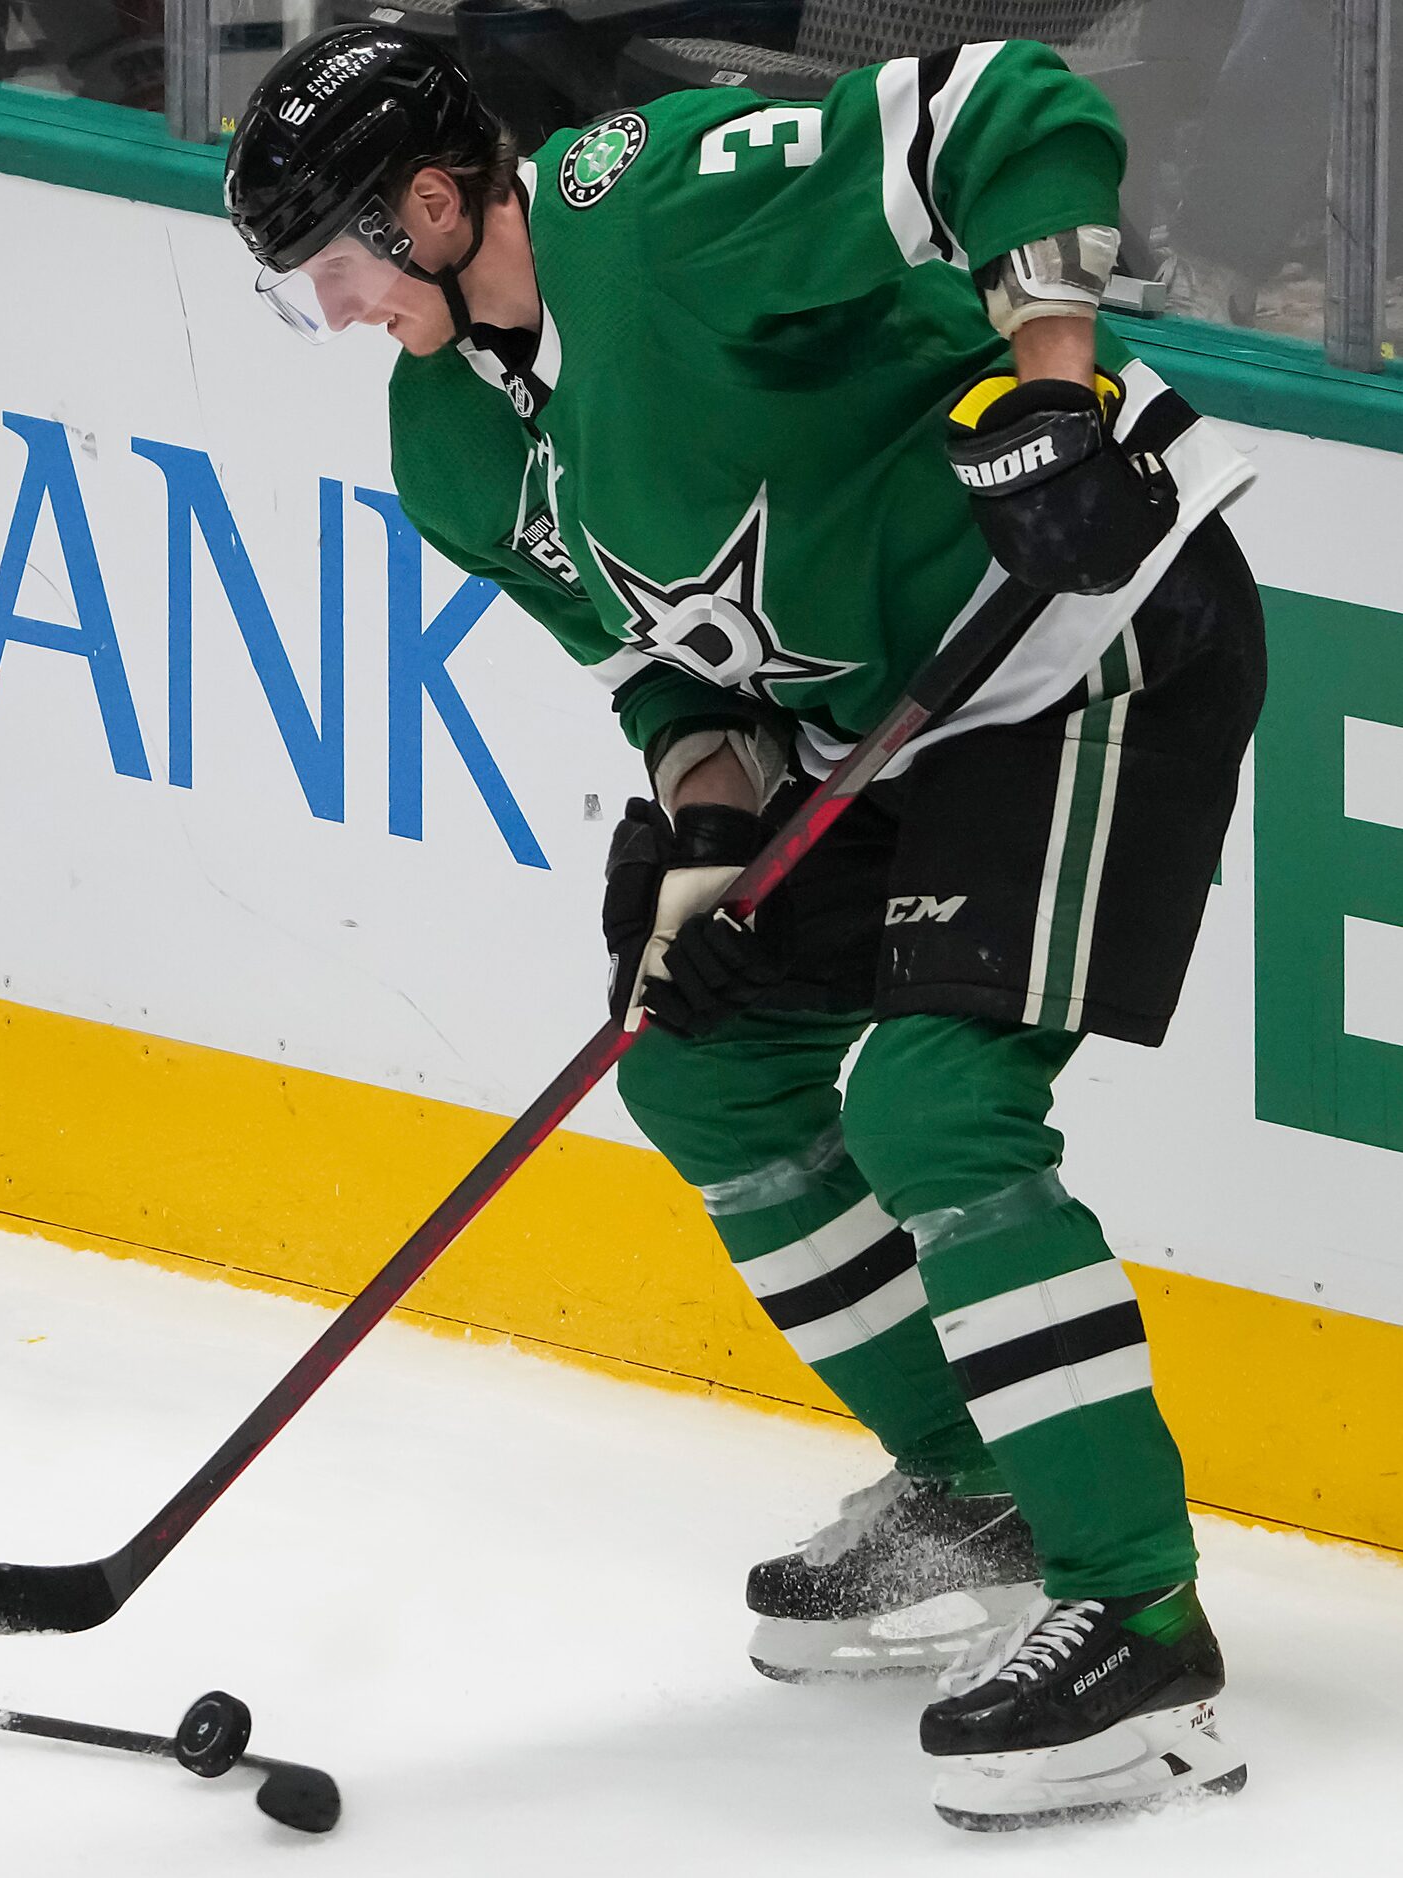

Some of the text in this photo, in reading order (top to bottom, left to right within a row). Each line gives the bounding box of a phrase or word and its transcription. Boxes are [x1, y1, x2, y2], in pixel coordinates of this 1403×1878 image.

[306, 49, 357, 93] ENERGY
[314, 51, 378, 100] TRANSFER
[564, 123, 610, 200] DALLAS
[601, 120, 640, 187] STARS
[699, 107, 823, 175] 3
[949, 435, 1059, 487] RIOR
[519, 514, 553, 546] ZUBOV
[884, 895, 968, 926] CM
